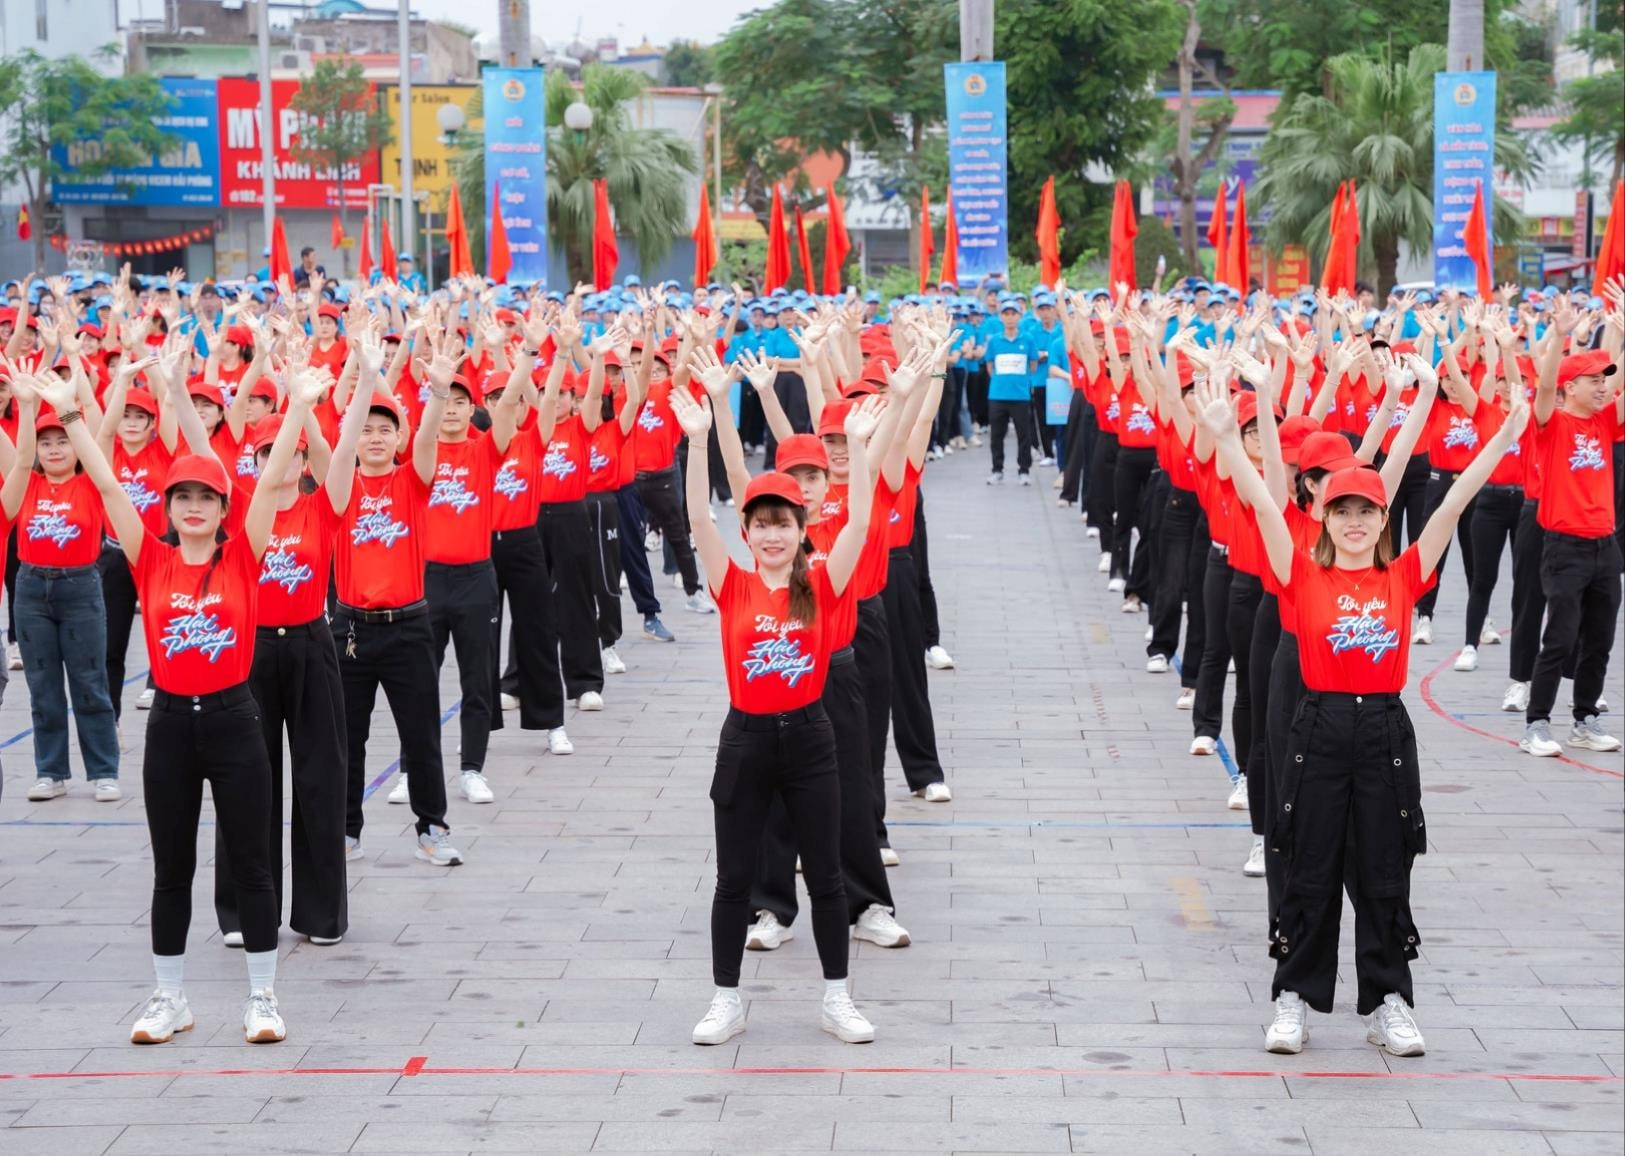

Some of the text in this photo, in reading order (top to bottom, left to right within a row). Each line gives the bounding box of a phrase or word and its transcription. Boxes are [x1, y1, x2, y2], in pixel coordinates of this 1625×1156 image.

[237, 155, 310, 180] KHÁNH
[606, 527, 618, 541] M
[170, 592, 222, 613] Tôi yêu
[1337, 594, 1387, 615] Tôi yêu
[755, 614, 779, 633] Tôi
